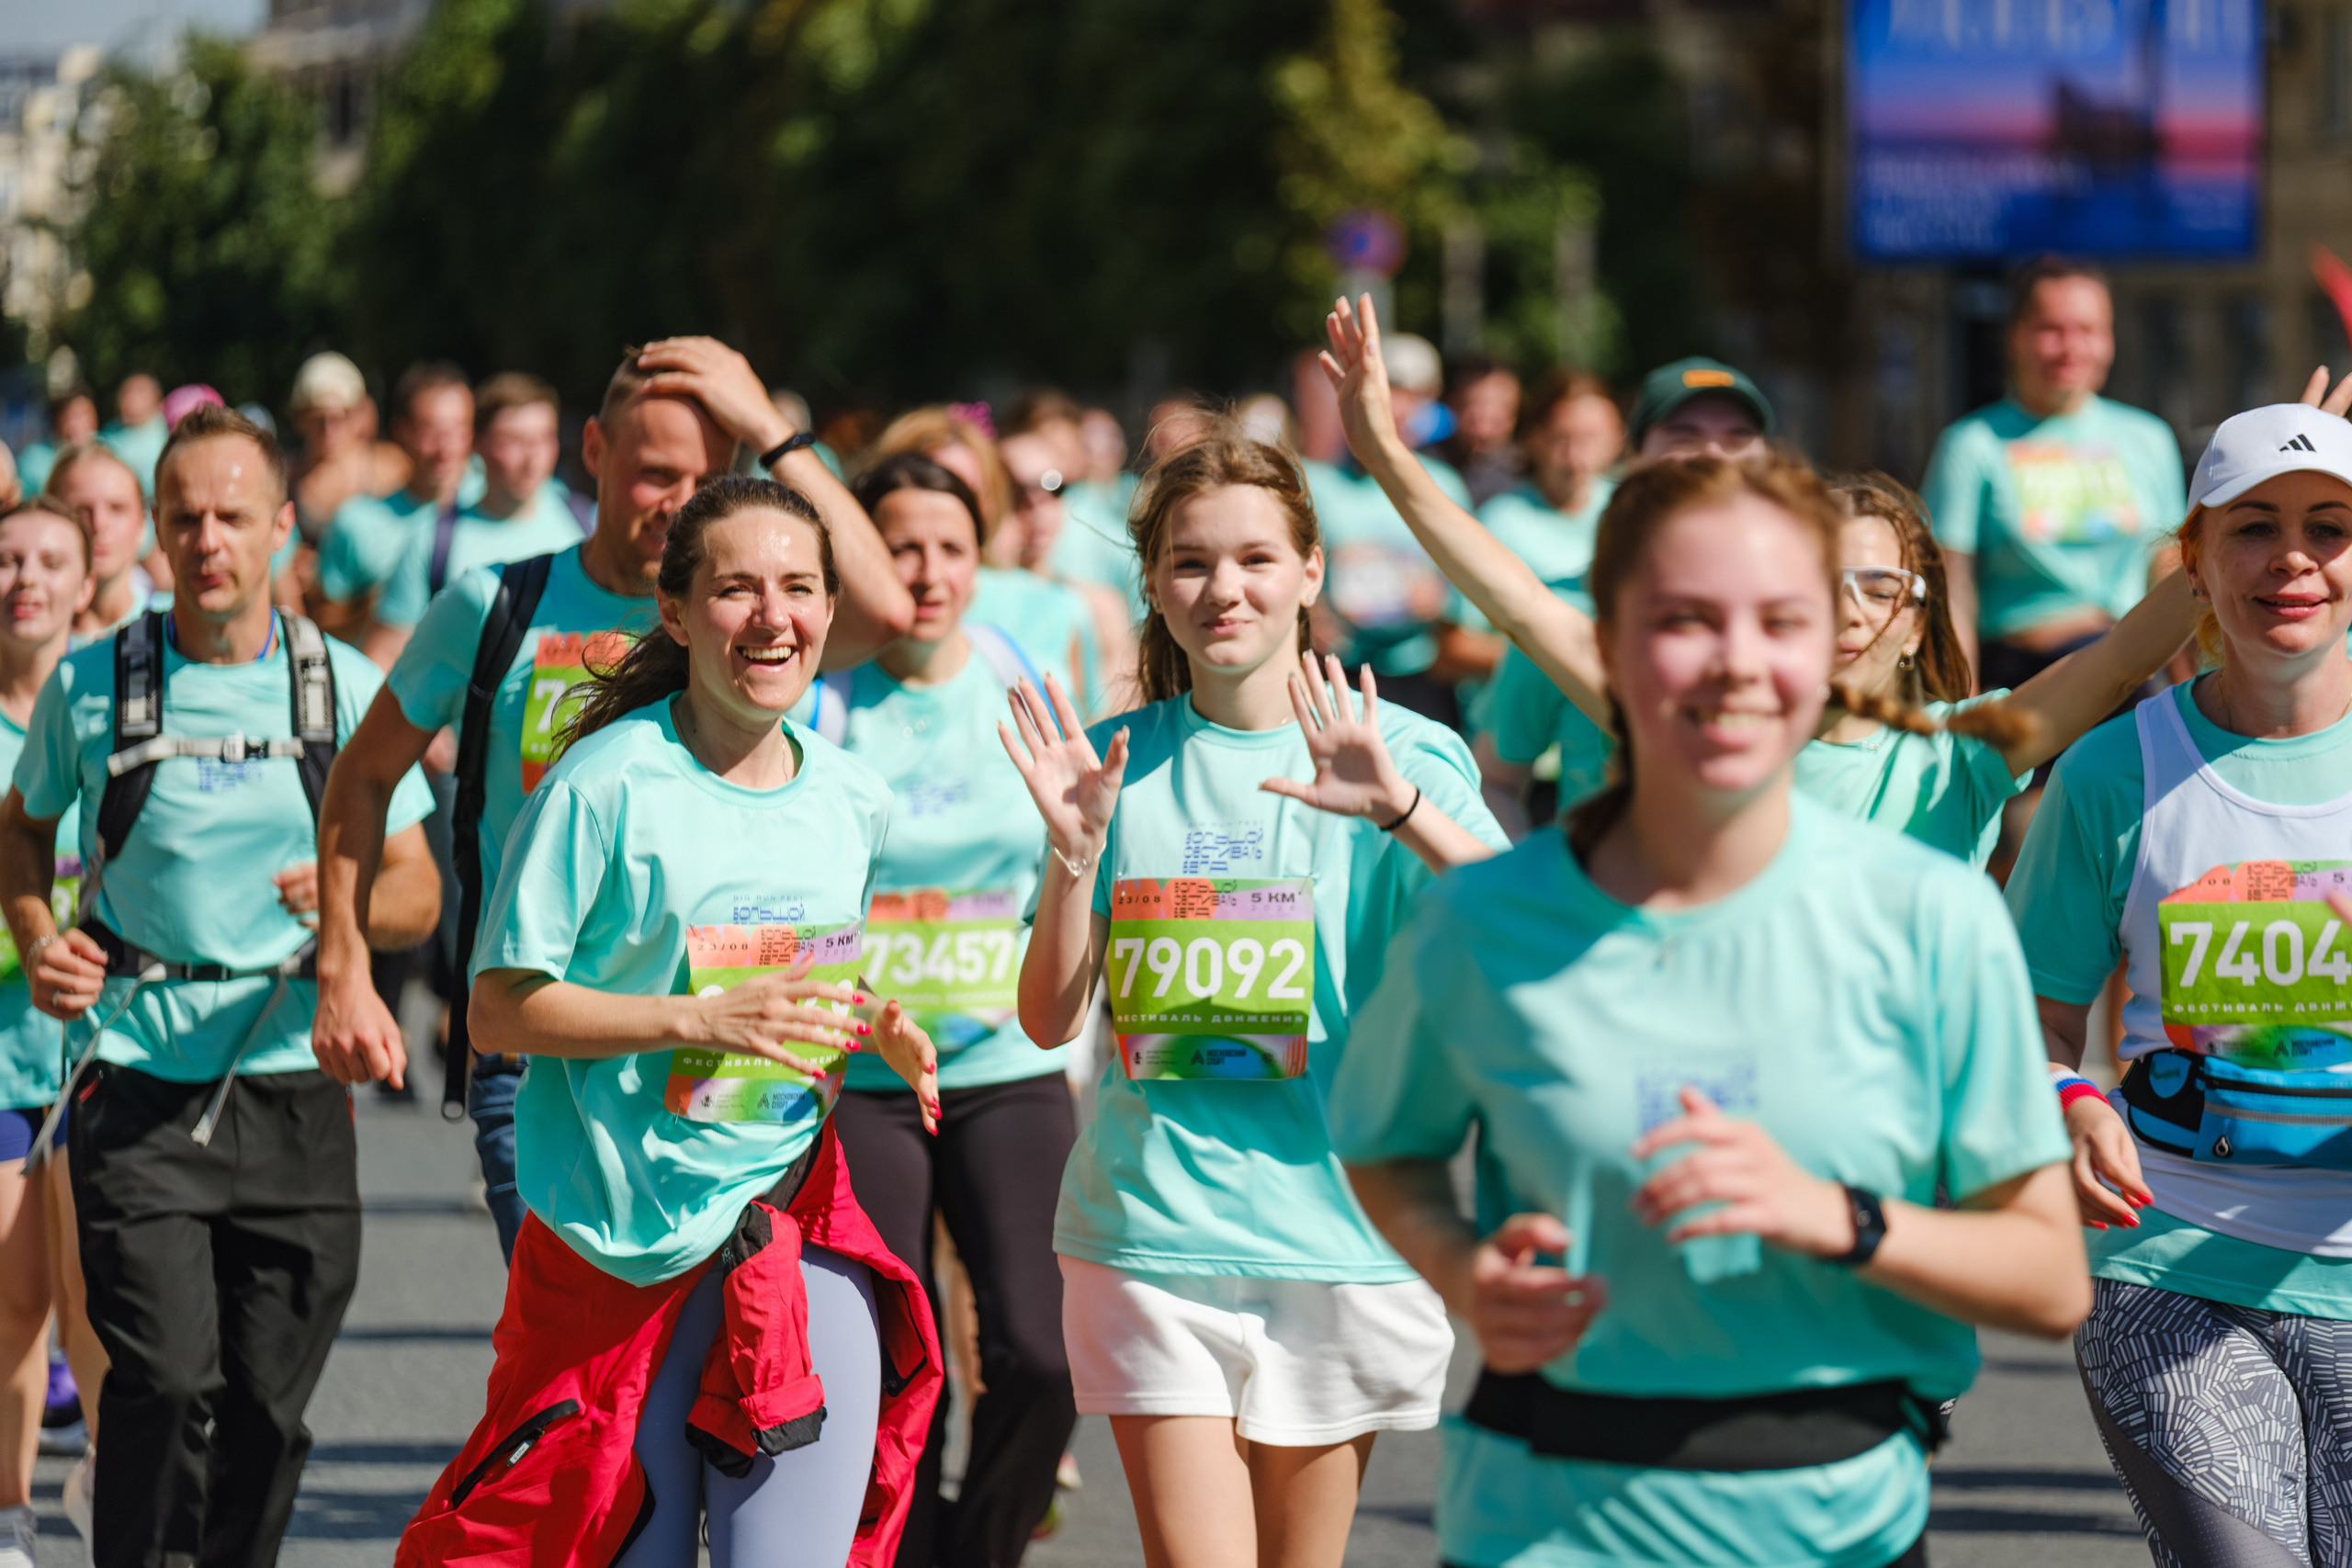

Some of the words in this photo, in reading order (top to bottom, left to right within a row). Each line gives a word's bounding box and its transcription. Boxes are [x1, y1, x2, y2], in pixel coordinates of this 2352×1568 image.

[1118, 896, 1160, 905] 23/08
[1251, 893, 1261, 902] 5
[826, 938, 834, 948] 5
[2170, 920, 2352, 987] 7404
[862, 931, 1015, 987] 73457
[1114, 937, 1306, 998] 79092
[2174, 1003, 2283, 1013] ФЕСТИВАЛЬ
[2295, 1001, 2352, 1012] ДВИЖ
[1117, 1014, 1202, 1022] ФЕСТИВАЛЬ
[1211, 1014, 1304, 1023] ДВИЖЕНИЯ
[683, 1057, 772, 1067] ФЕСТИВАЛЬ
